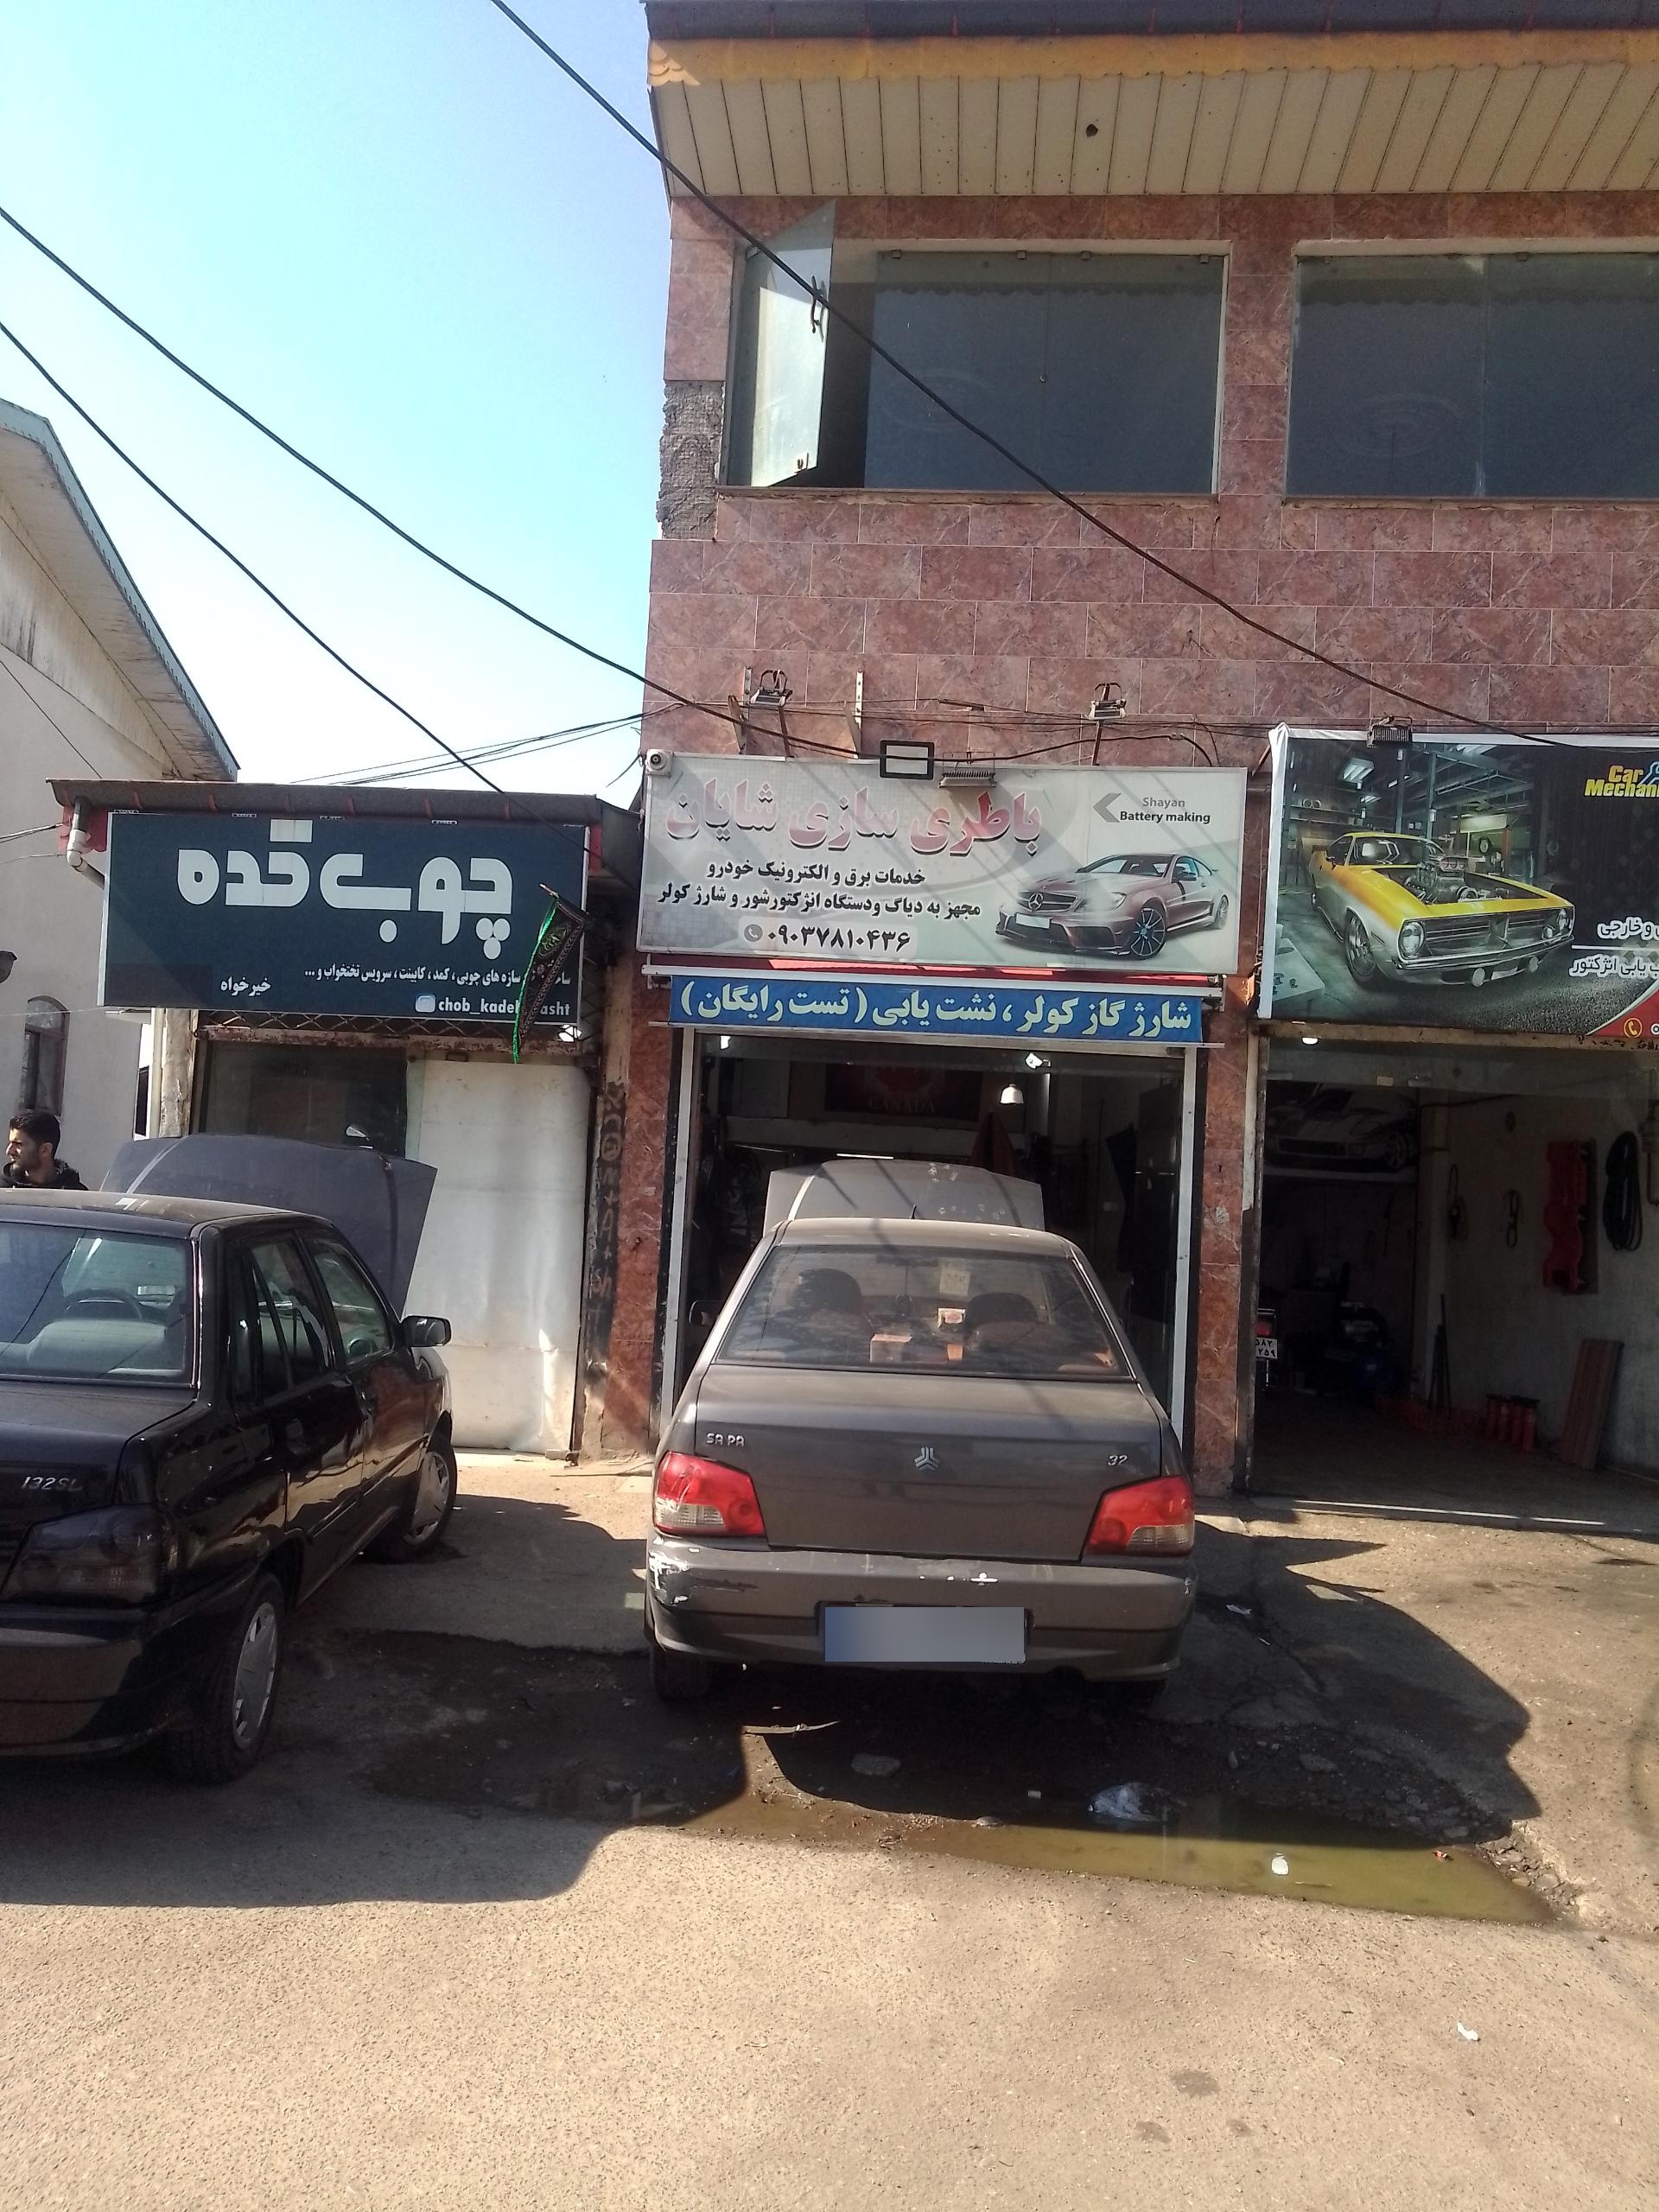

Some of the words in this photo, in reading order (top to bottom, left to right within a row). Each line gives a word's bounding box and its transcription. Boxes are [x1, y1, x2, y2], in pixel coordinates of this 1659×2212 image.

[1608, 765, 1644, 783] Car
[665, 778, 779, 842] شایان
[1141, 797, 1186, 810] Shayan
[788, 786, 899, 852] سازی
[908, 791, 1042, 857] باطری
[1119, 810, 1164, 824] Battery
[1166, 811, 1211, 825] making
[706, 859, 754, 880] خودرو
[758, 861, 830, 884] الکترونیک
[831, 871, 841, 886] و
[844, 868, 871, 887] برق
[874, 868, 926, 885] خدمات
[657, 881, 691, 904] کولر
[692, 885, 727, 906] شارژ
[729, 892, 739, 908] و
[885, 897, 923, 918] دیاگ
[926, 901, 941, 919] به
[944, 901, 982, 920] مجهز
[767, 924, 912, 953] ۰۹۰۳۷۸۱۰۴۳۶
[323, 963, 360, 982] تختخواب
[1572, 956, 1618, 975] انژکتور
[1620, 958, 1646, 976] یابی
[361, 968, 392, 983] سرویس
[482, 969, 500, 986] های
[501, 969, 522, 988] سازه
[220, 976, 271, 997] خیرخواه
[872, 989, 931, 1027] یابی
[936, 992, 996, 1021] نشت
[1082, 996, 1126, 1035] گاز
[1128, 1000, 1192, 1038] شارژ
[868, 1097, 936, 1115] CANADA
